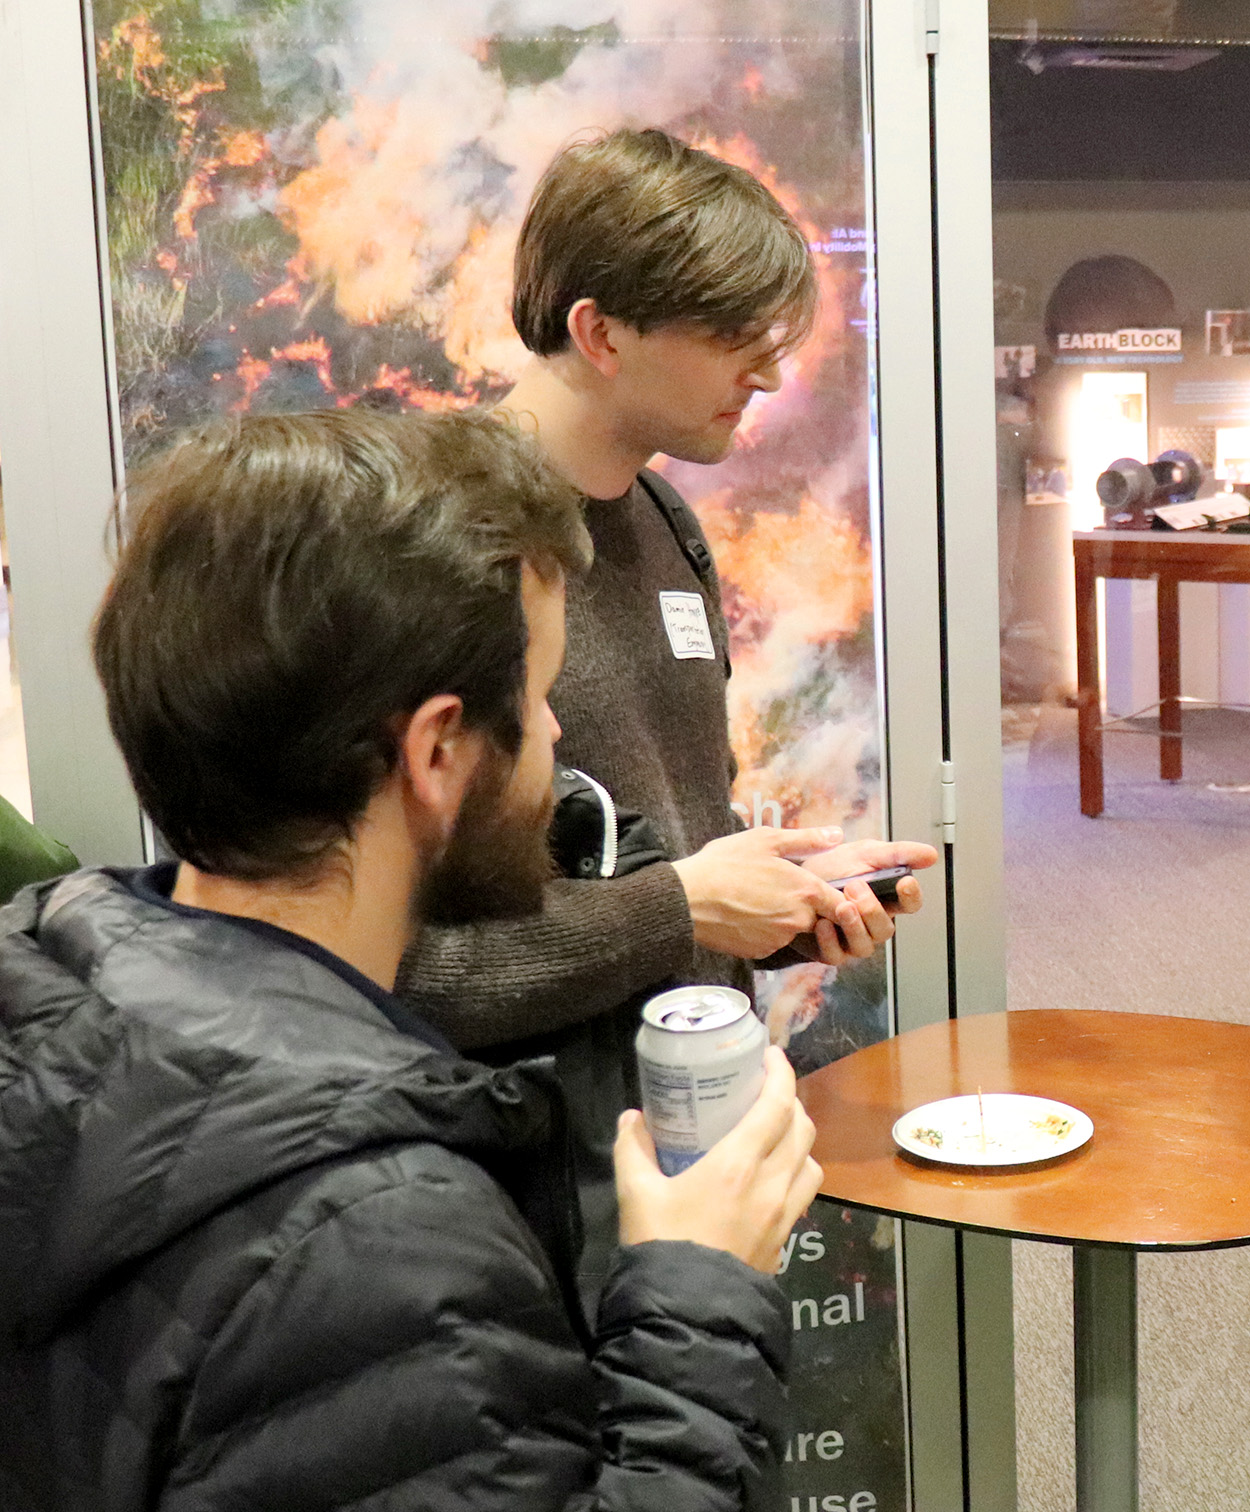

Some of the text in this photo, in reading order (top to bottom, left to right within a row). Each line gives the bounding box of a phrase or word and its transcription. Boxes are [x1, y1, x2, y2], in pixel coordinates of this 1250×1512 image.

[1058, 333, 1178, 349] EARTHBLOCK
[792, 1282, 865, 1331] nal
[784, 1430, 844, 1462] re
